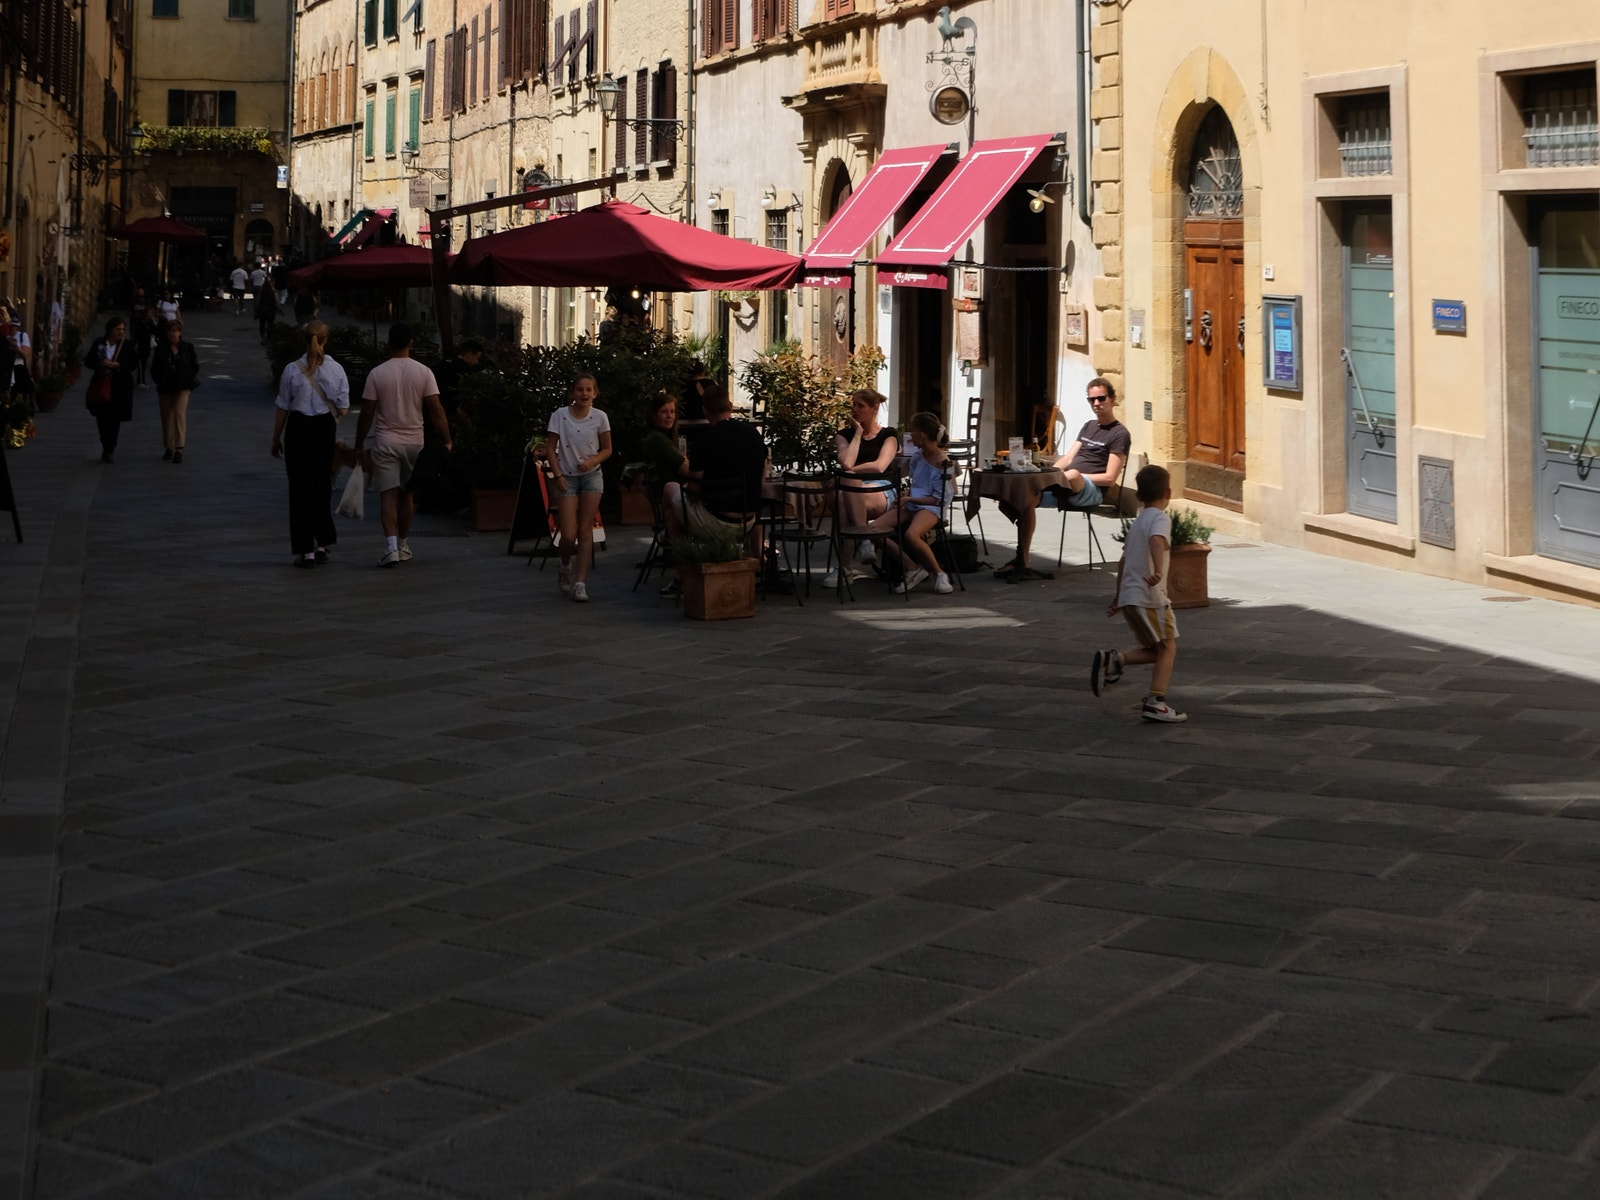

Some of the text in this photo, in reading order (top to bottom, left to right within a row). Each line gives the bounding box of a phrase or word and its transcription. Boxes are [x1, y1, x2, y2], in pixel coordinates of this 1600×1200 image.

[926, 56, 934, 64] N
[1435, 307, 1461, 318] FINECO
[1560, 300, 1599, 315] FINECO
